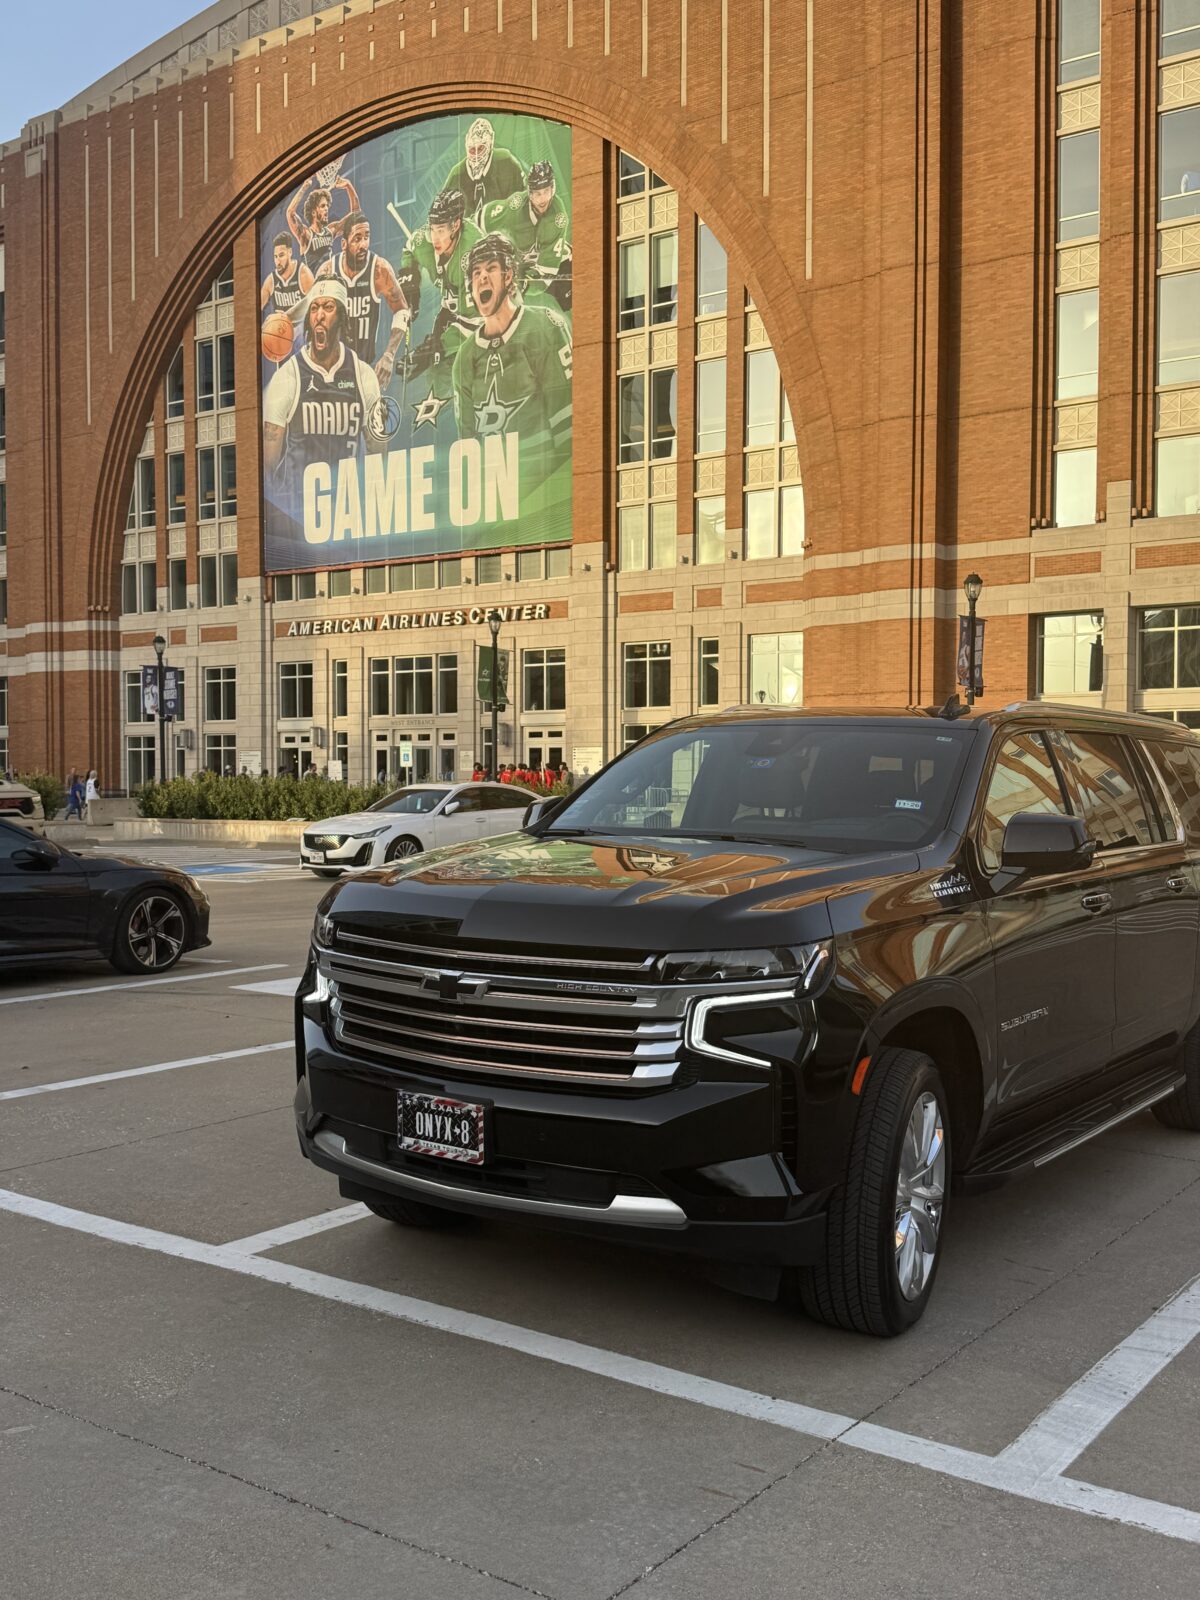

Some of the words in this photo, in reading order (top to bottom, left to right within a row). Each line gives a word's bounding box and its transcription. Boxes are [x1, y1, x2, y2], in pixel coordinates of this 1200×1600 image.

[274, 290, 302, 307] MAVS
[345, 295, 371, 318] AVS
[358, 317, 370, 340] 11
[302, 401, 361, 437] MAVS
[303, 445, 435, 544] GAME
[449, 431, 519, 527] ON
[287, 616, 375, 636] AMERICAN
[380, 609, 464, 630] AIRLINES
[468, 603, 548, 625] CENTER
[585, 984, 638, 994] COUNTRY
[423, 1100, 461, 1115] TEXAS
